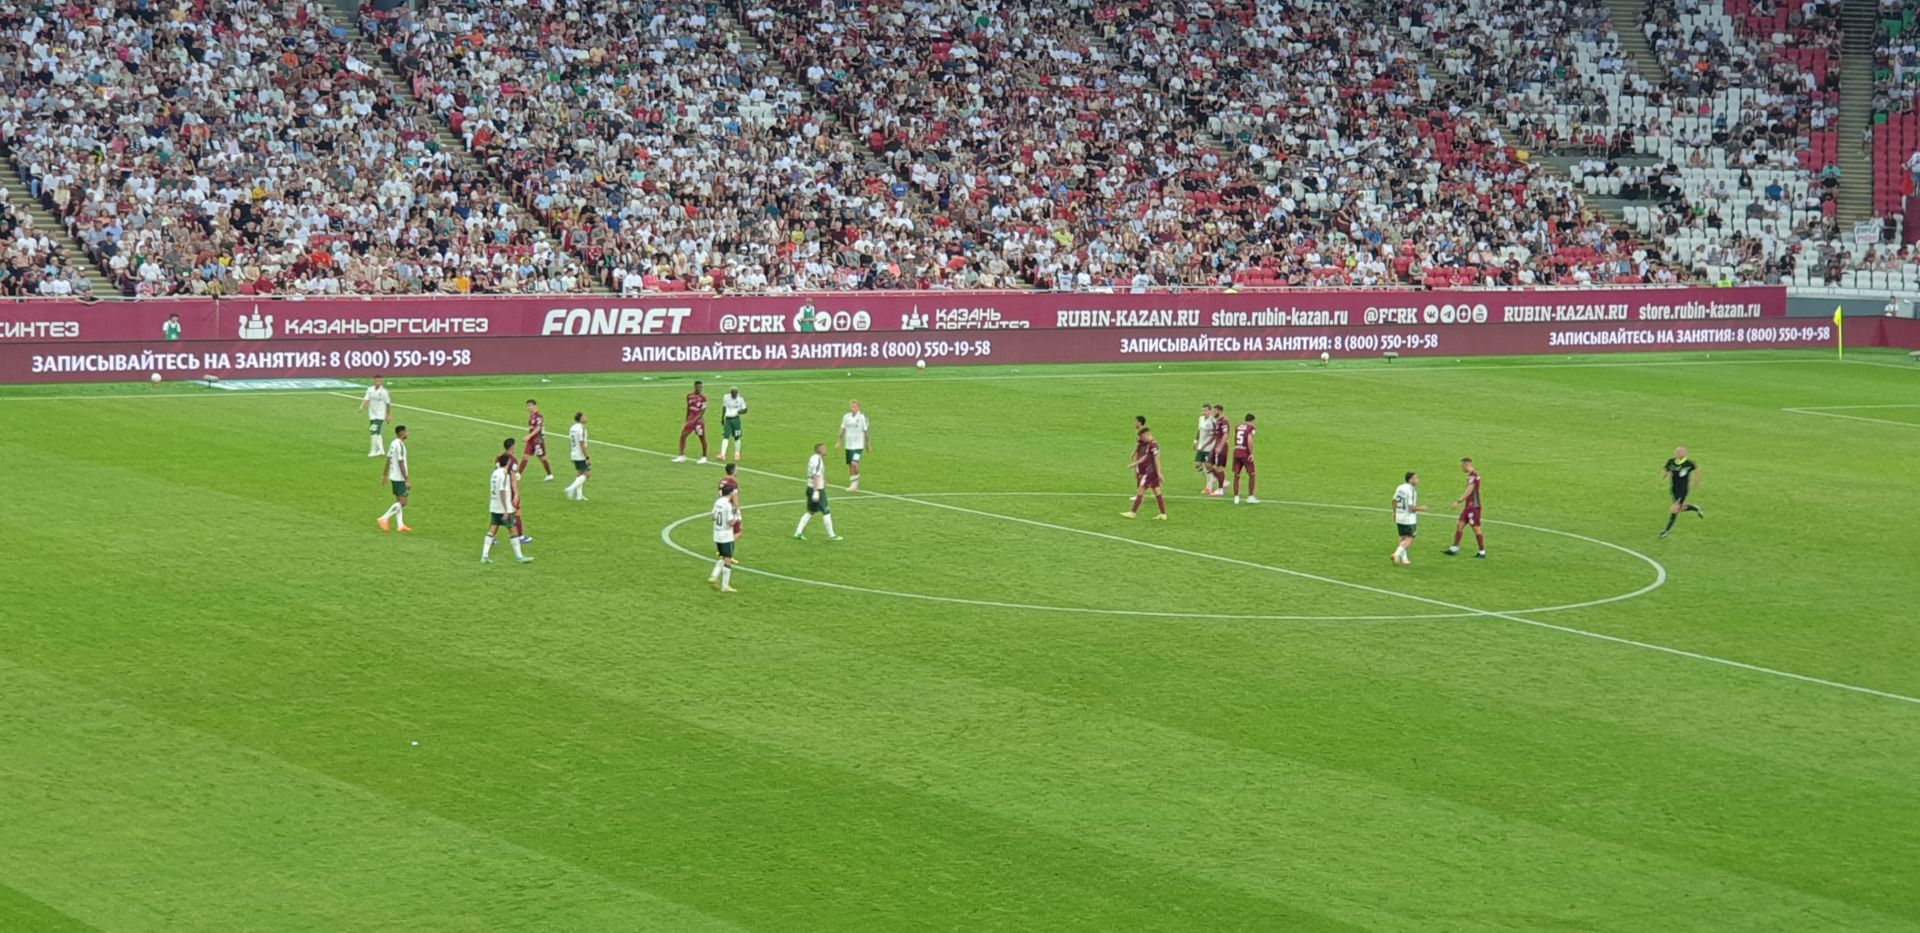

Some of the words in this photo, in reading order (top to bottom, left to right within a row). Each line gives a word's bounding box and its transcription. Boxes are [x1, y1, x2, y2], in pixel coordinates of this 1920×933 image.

[936, 308, 1001, 321] КАЗАНЬ
[1057, 310, 1200, 327] RUBIN-KAZAN.RU
[1212, 308, 1348, 326] store.rubin-kazan.ru
[1364, 307, 1417, 324] @FCRK
[1504, 305, 1628, 321] RUBIN-KAZAN.RU
[1639, 302, 1760, 319] store.rubin-kazan.ru
[285, 318, 488, 334] КАЗАНЬОРГСИНТЕЗ
[542, 308, 691, 335] FONBET
[720, 314, 785, 333] @FCRK
[1120, 334, 1240, 353] ЗАПИСЫВАЙТЕСЬ
[1244, 337, 1263, 351] НА
[1266, 336, 1331, 351] ЗАНЯТИЯ:
[1334, 336, 1341, 349] 8
[1345, 335, 1378, 351] (800)
[1381, 334, 1438, 349] 550-19-58
[1549, 328, 1654, 345] ЗАПИСЫВАЙТЕСЬ
[1657, 330, 1674, 343] НА
[1676, 329, 1735, 343] ЗАНЯТИЯ:
[1737, 329, 1744, 341] 8
[1747, 328, 1776, 343] (800)
[1779, 327, 1829, 341] 550-19-58
[622, 342, 761, 361] ЗАПИСЫВАЙТЕСЬ
[765, 345, 787, 359] НА
[791, 343, 867, 359] ЗАНЯТИЯ:
[871, 343, 879, 357] 8
[882, 341, 921, 358] (800)
[925, 341, 990, 357] 550-19-58
[32, 350, 200, 372] ЗАПИСЫВАЙТЕСЬ
[205, 353, 231, 369] НА
[235, 352, 326, 369] ЗАНЯТИЯ:
[330, 352, 340, 367] 8
[344, 350, 390, 369] (800)
[394, 350, 471, 367] 550-19-58
[1236, 430, 1245, 445] 5
